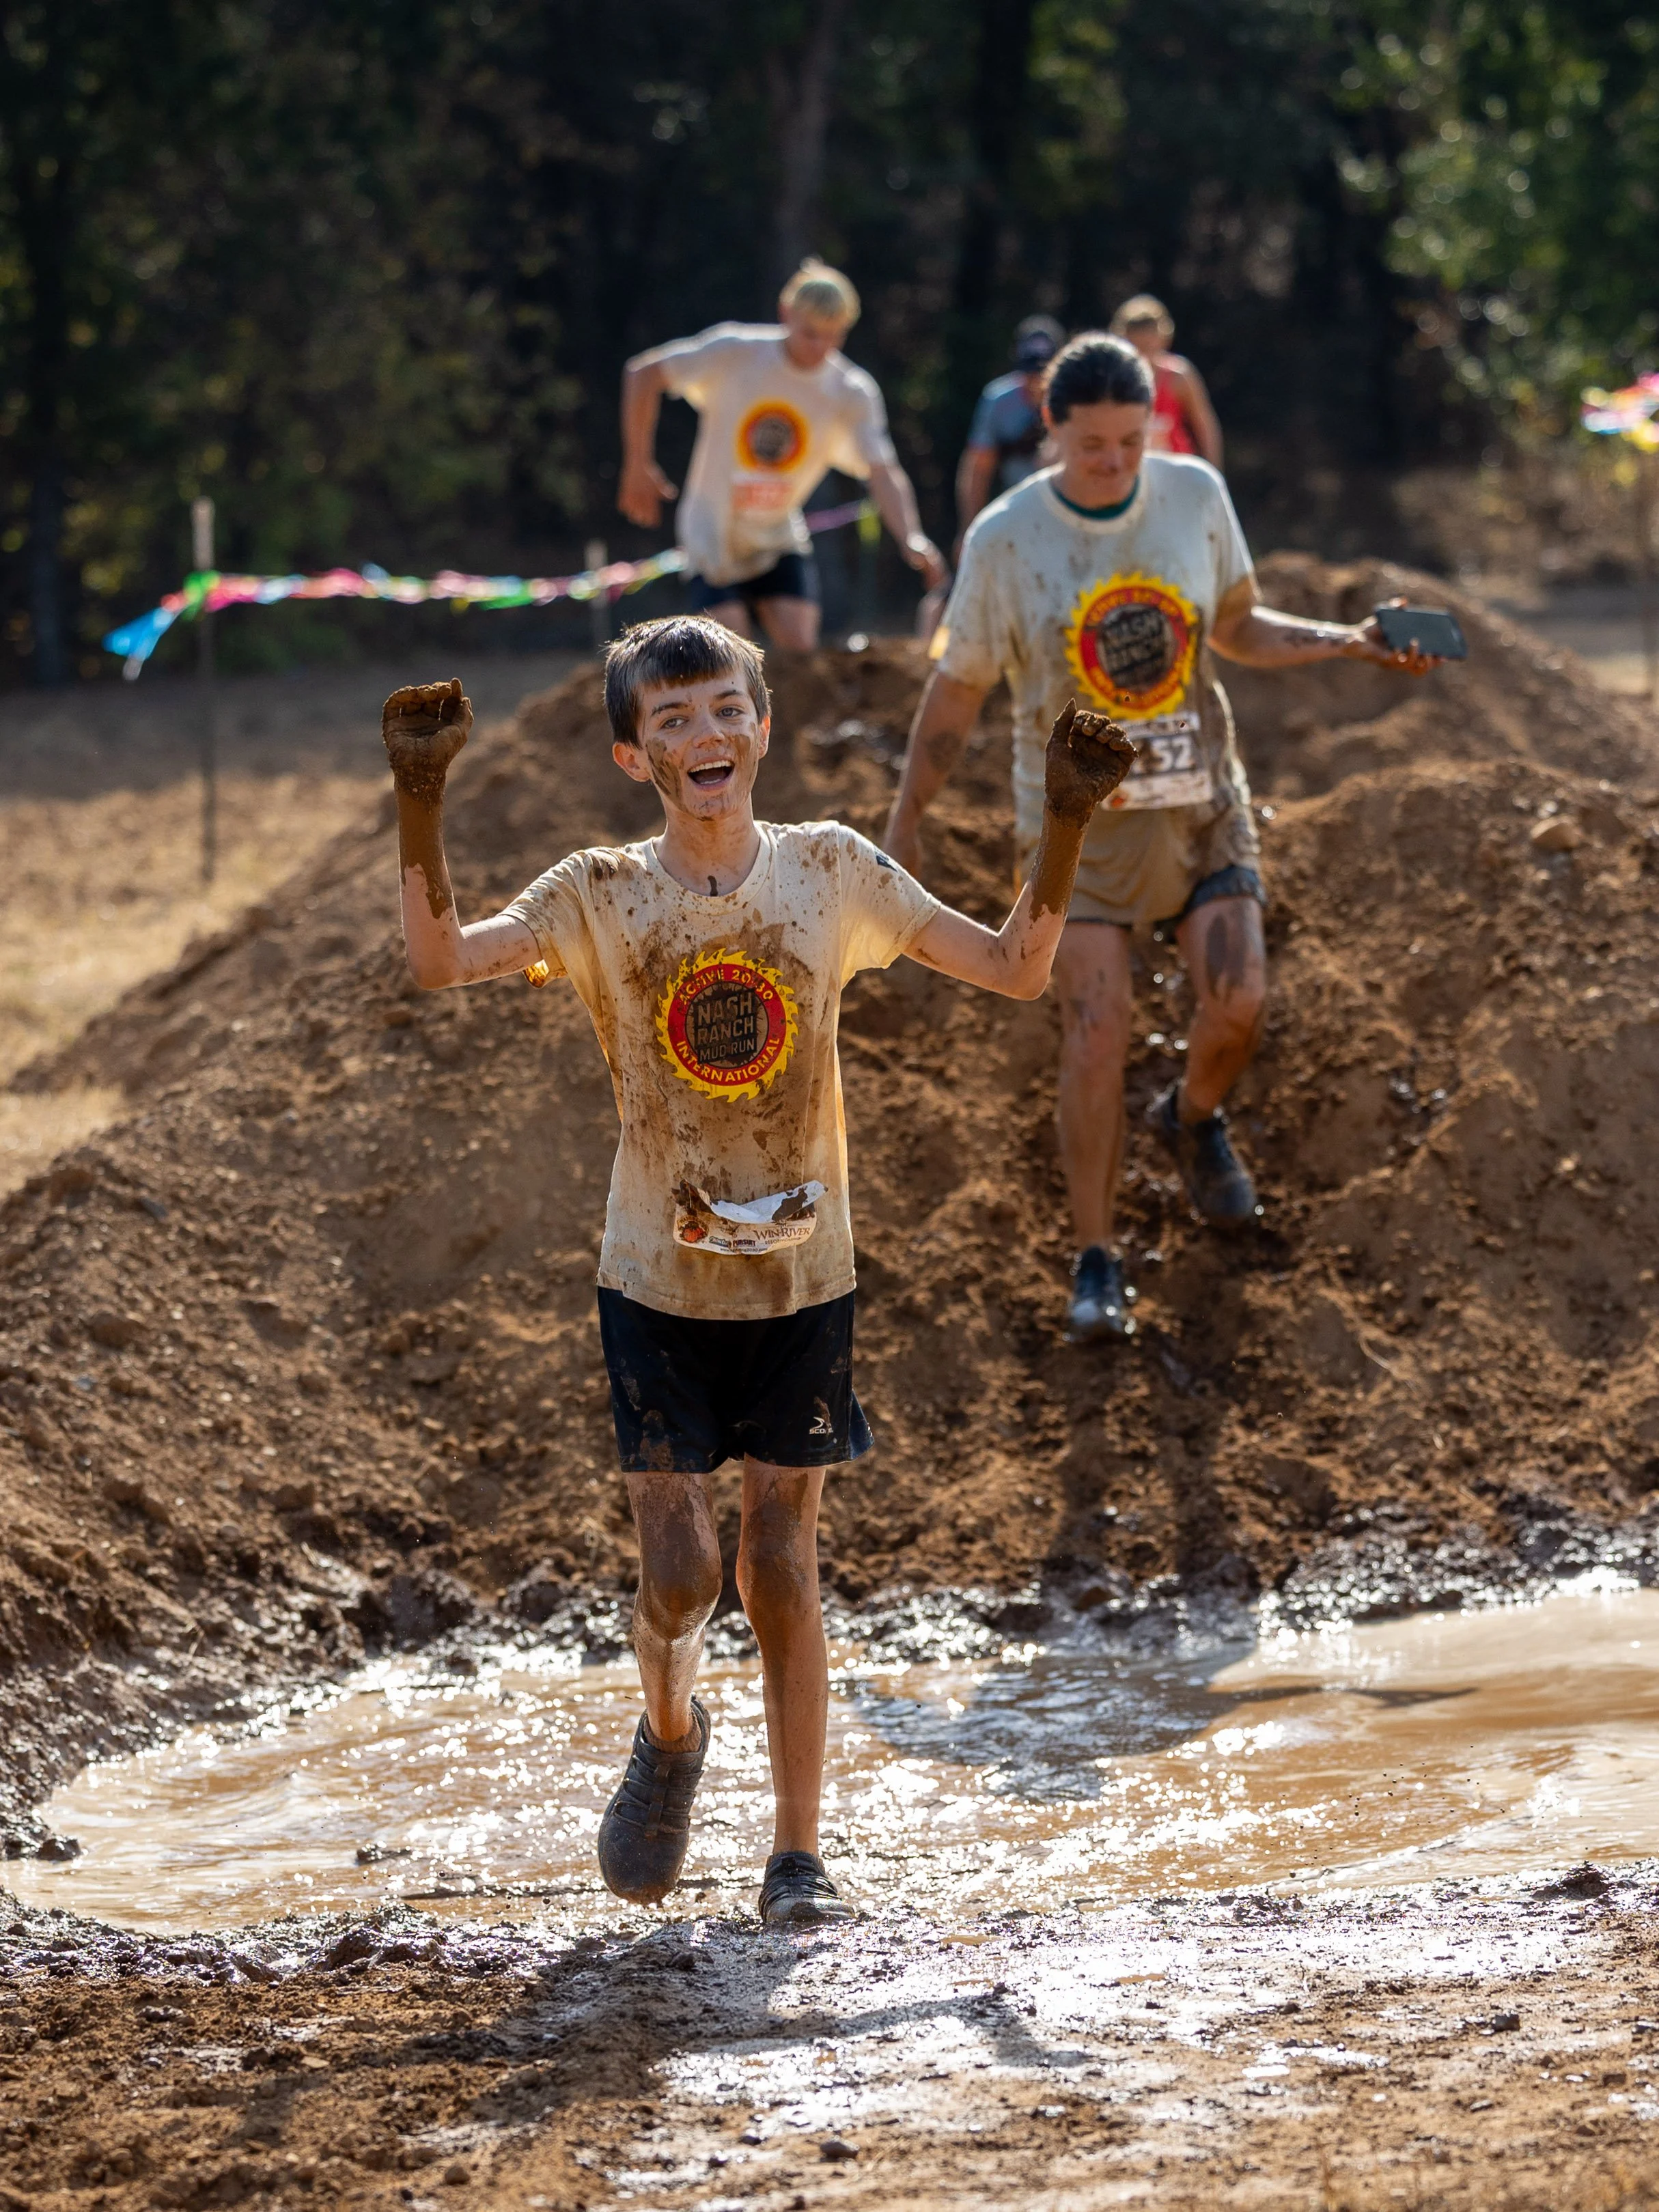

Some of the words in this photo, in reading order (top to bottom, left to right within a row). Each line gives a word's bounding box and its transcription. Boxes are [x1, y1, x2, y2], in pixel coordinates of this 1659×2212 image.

[680, 969, 724, 1005] ACTIVE
[697, 991, 752, 1024] NASH
[697, 1016, 754, 1045] RANCH
[676, 1037, 780, 1082] INTERNATIONAL
[699, 1044, 726, 1061] MUD
[731, 1039, 755, 1055] RUN
[753, 1227, 811, 1241] WIN-RIVER
